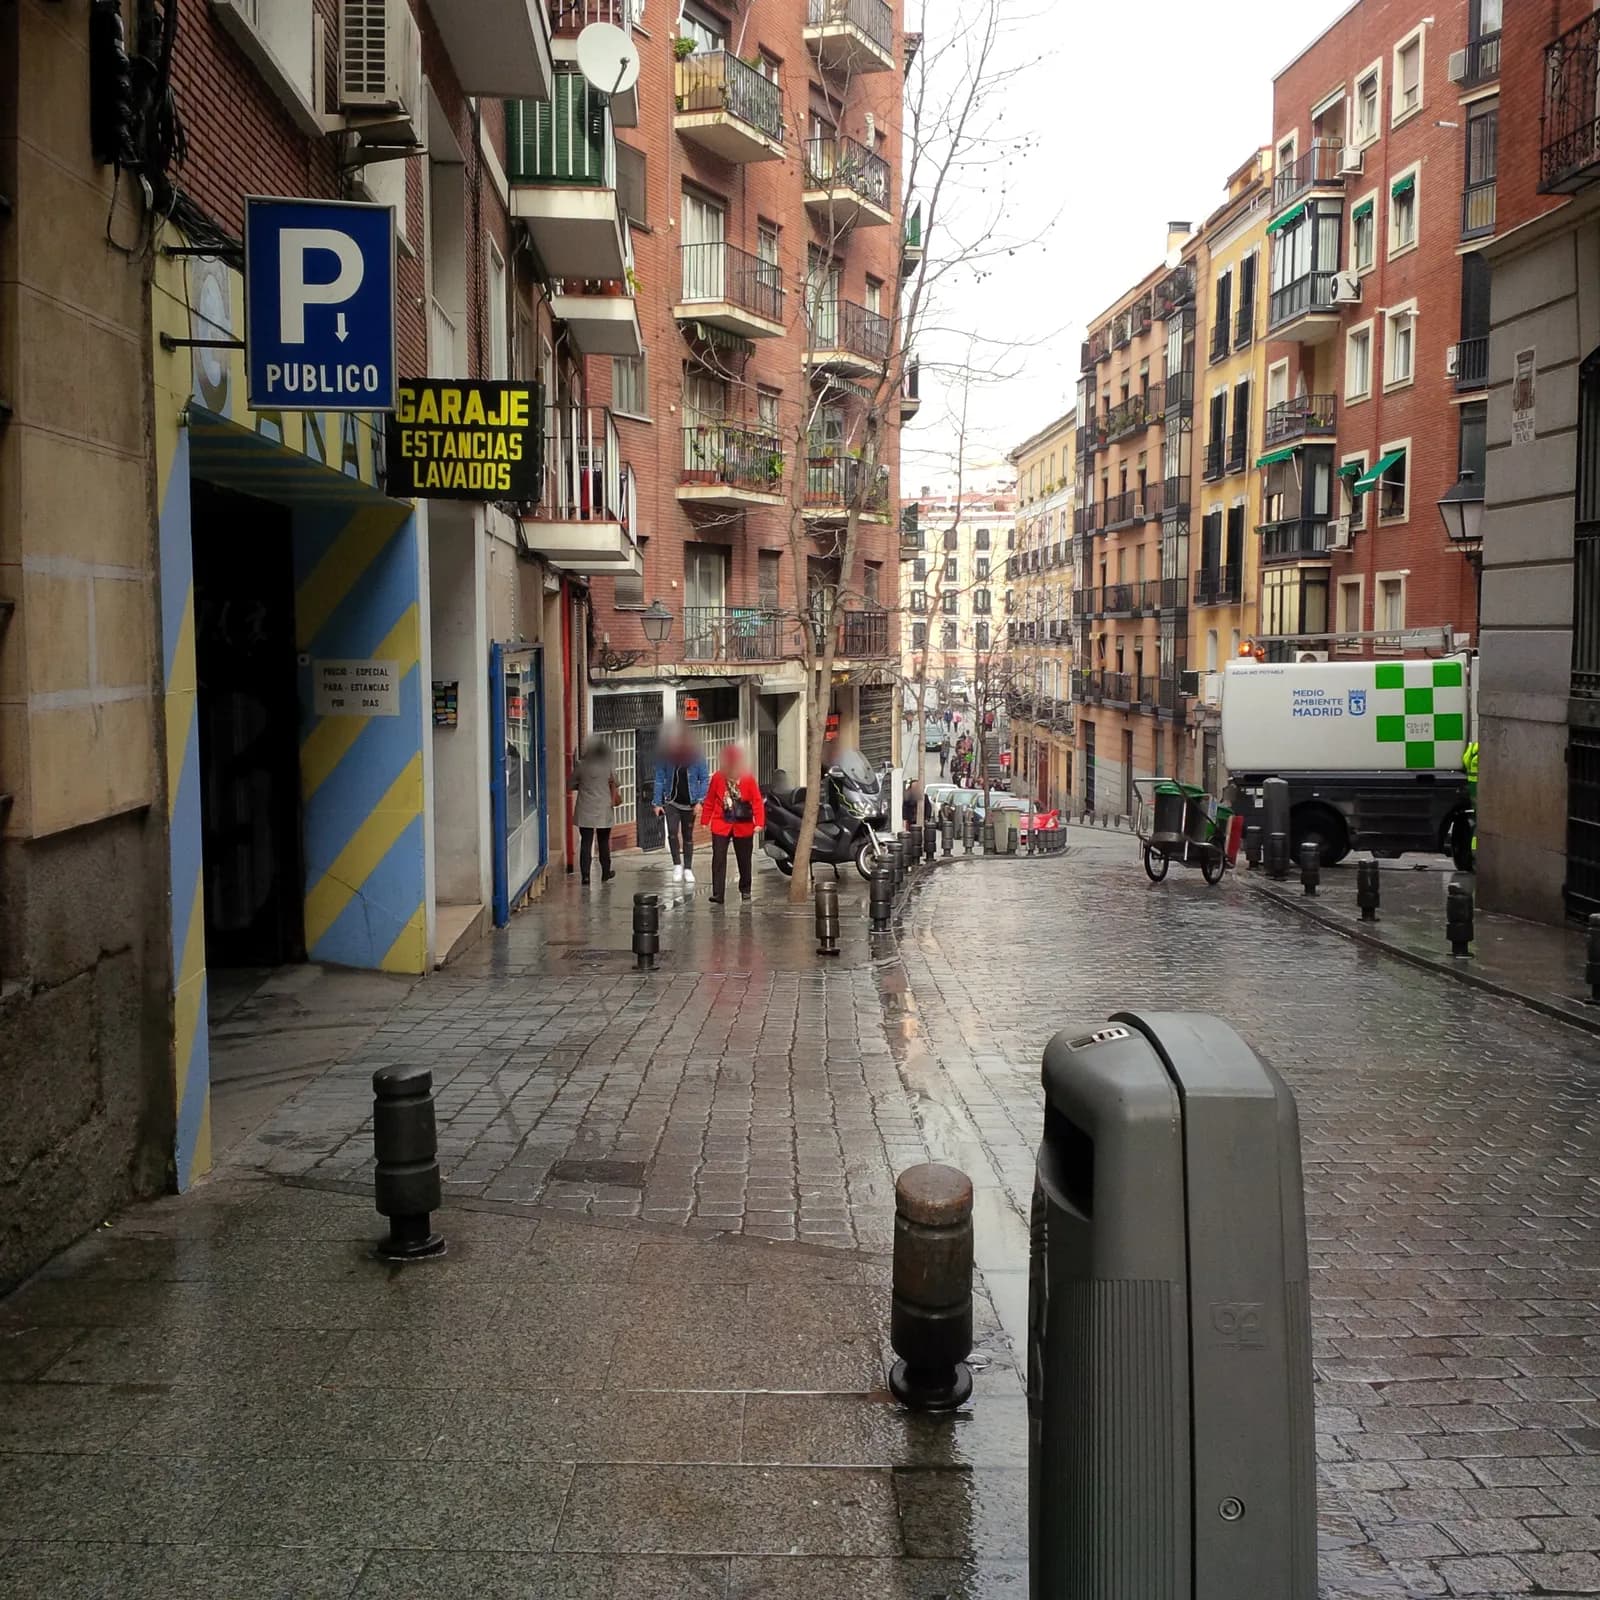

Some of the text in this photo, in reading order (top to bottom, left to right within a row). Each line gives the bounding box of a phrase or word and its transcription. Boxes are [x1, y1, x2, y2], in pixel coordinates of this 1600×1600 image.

[279, 228, 364, 344] P
[266, 363, 379, 393] PUBLICO
[396, 388, 529, 426] GARAJE
[402, 430, 522, 460] ESTANCIAS
[413, 462, 511, 490] LAVADOS
[355, 667, 389, 677] ESPECIAL
[350, 683, 390, 692] ESTANCIAS
[1292, 689, 1325, 697] MEDIO
[1293, 698, 1344, 706] AMBIENTE
[1292, 707, 1343, 717] MADRID
